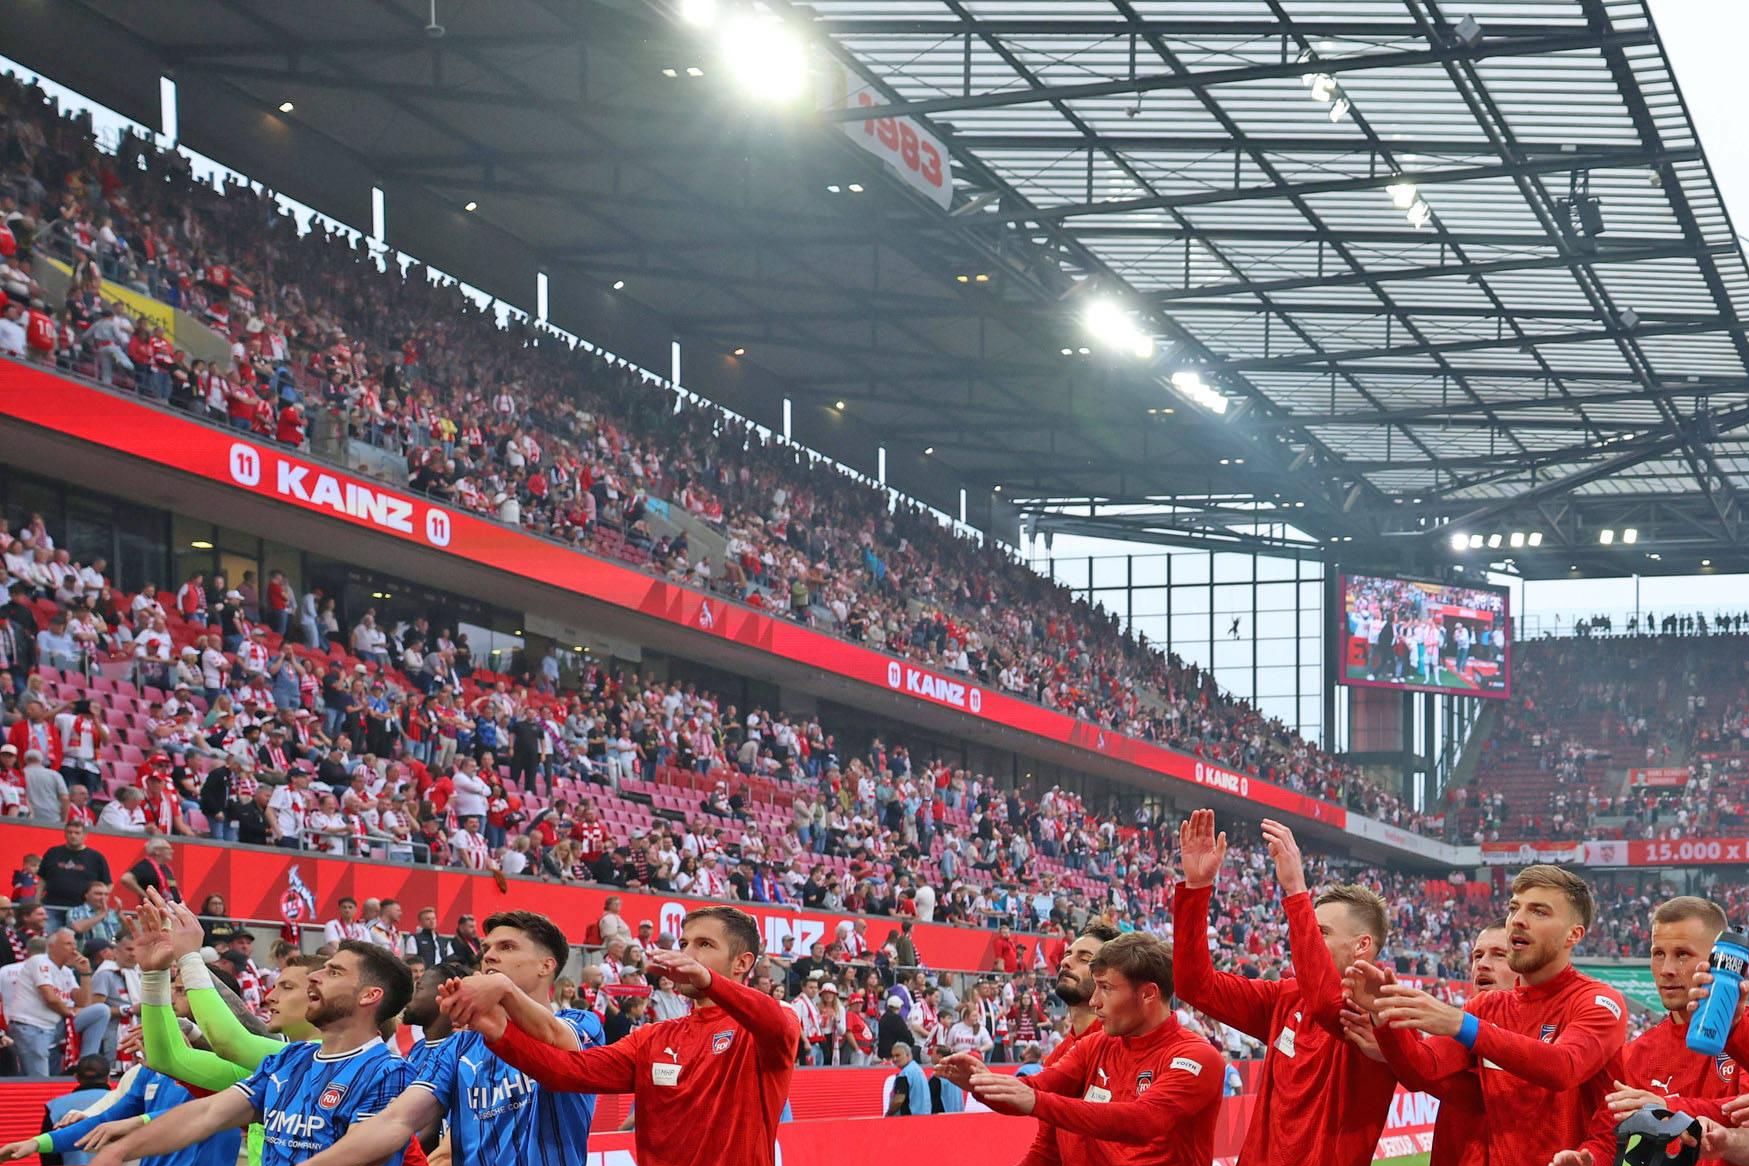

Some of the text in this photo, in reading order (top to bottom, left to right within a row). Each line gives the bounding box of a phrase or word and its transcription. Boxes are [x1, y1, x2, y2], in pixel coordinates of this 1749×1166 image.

[237, 453, 444, 538] 11 KAINZ 11
[907, 669, 965, 705] KAINZ
[1646, 842, 1722, 862] 15.000
[1727, 845, 1742, 859] x
[1601, 998, 1619, 1015] VOITH
[1175, 1060, 1197, 1071] VOITH
[1722, 1064, 1735, 1076] FC
[323, 1094, 338, 1104] FCH
[277, 1110, 325, 1138] MHP
[265, 1136, 323, 1151] SCHE COMPANY
